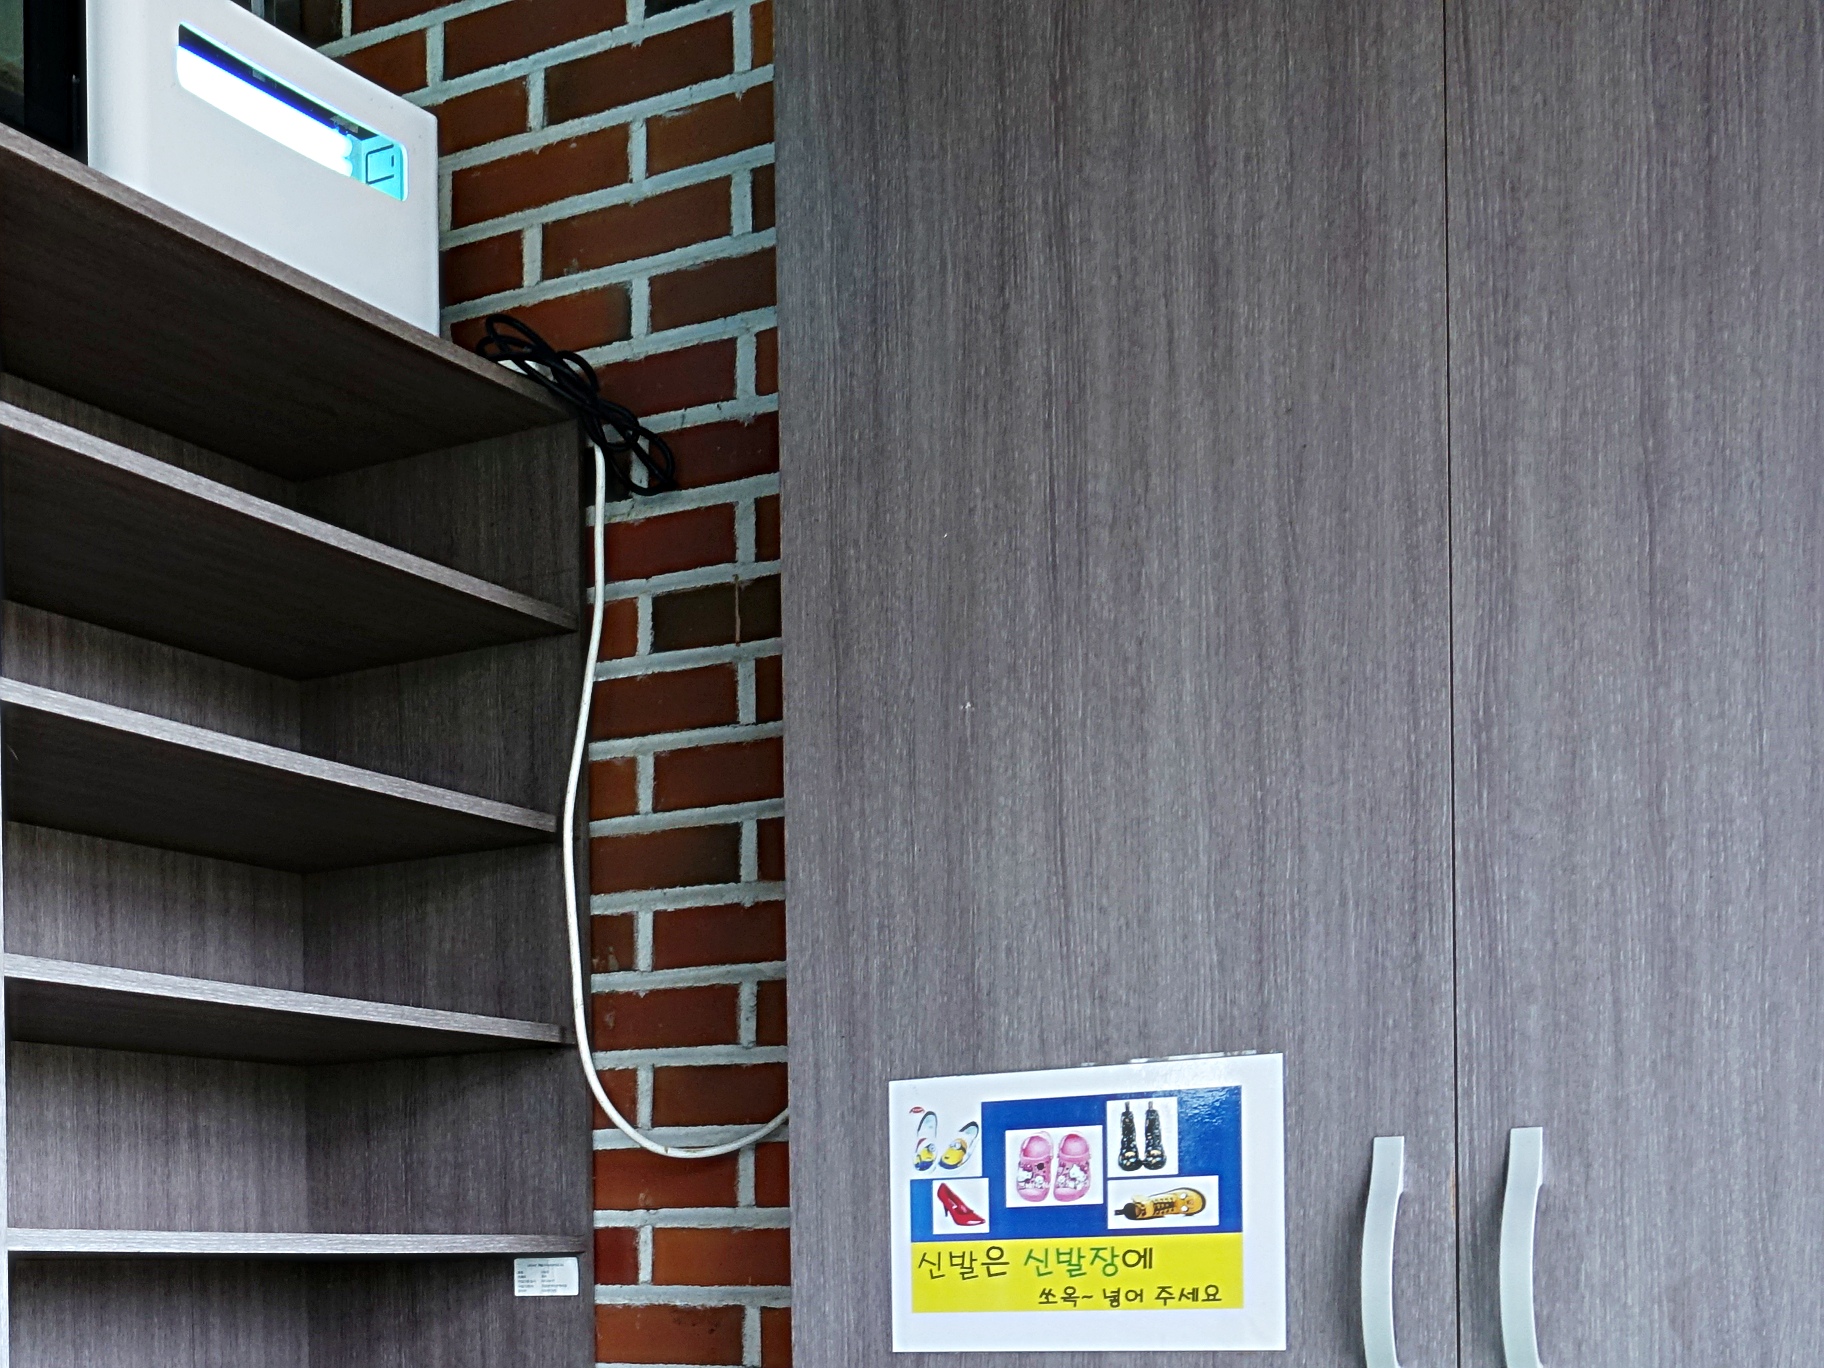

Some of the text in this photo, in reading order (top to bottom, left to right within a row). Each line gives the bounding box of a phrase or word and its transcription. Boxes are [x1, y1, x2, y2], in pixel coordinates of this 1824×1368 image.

[918, 1245, 1153, 1280] 신발은 신발장에
[1102, 1287, 1144, 1308] 넣어
[1154, 1284, 1222, 1306] 주세요
